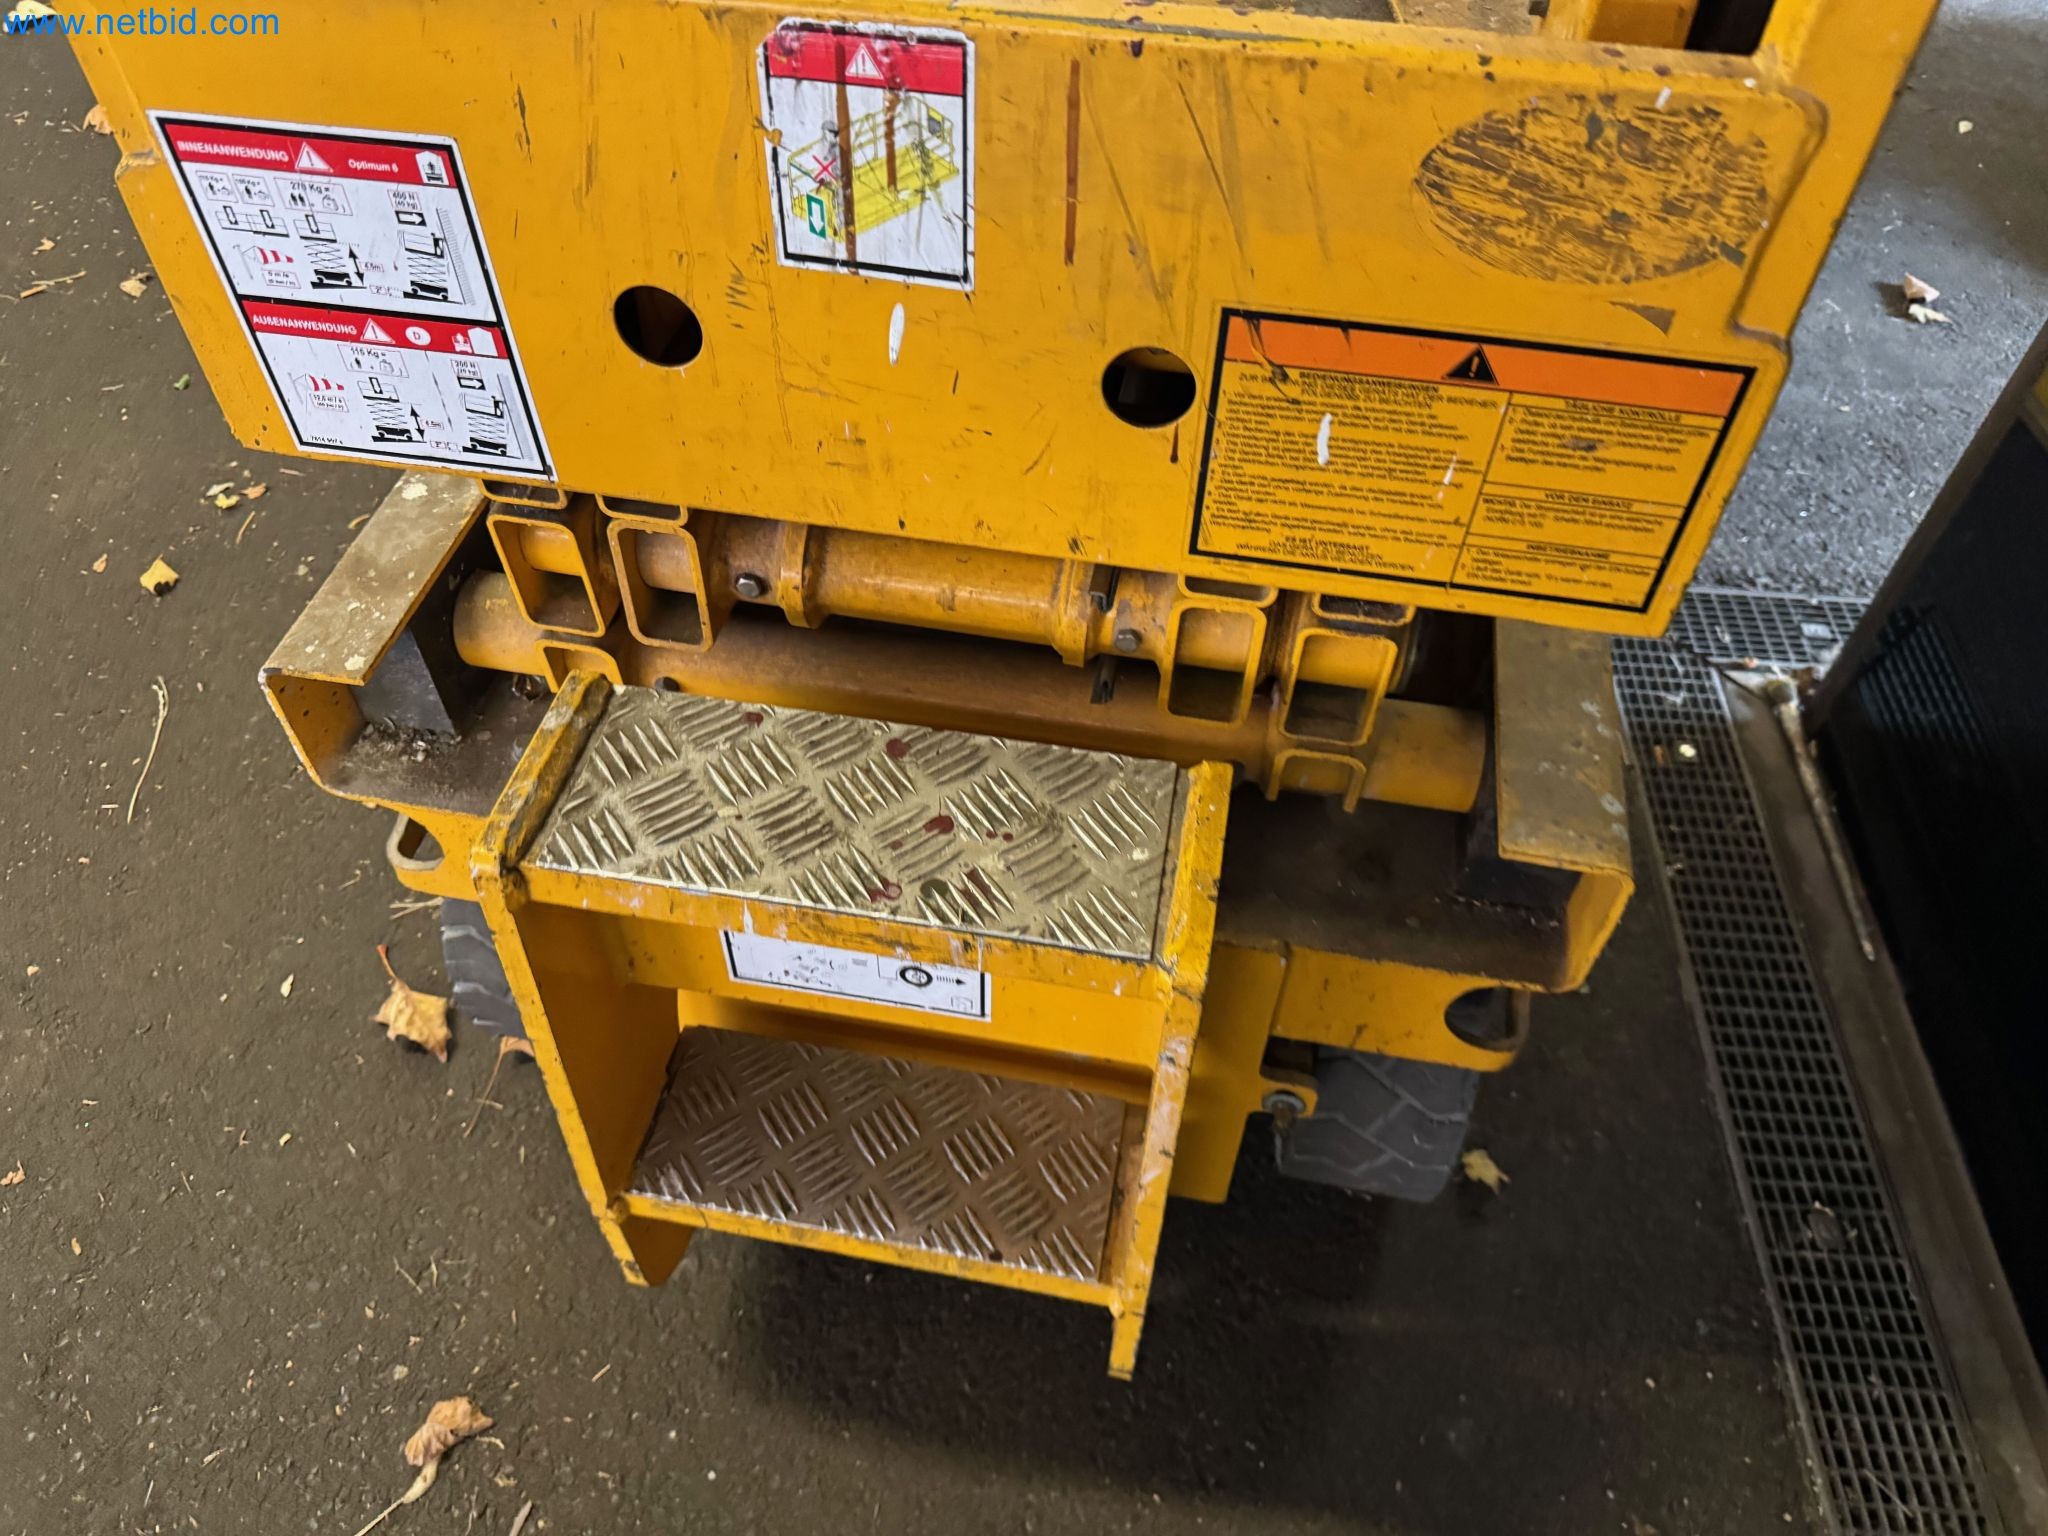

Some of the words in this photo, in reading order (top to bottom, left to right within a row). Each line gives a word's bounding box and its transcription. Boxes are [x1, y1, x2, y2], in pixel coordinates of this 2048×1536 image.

[176, 141, 289, 162] INNENANWENDUNG
[348, 158, 391, 172] Optimum
[412, 331, 421, 341] D
